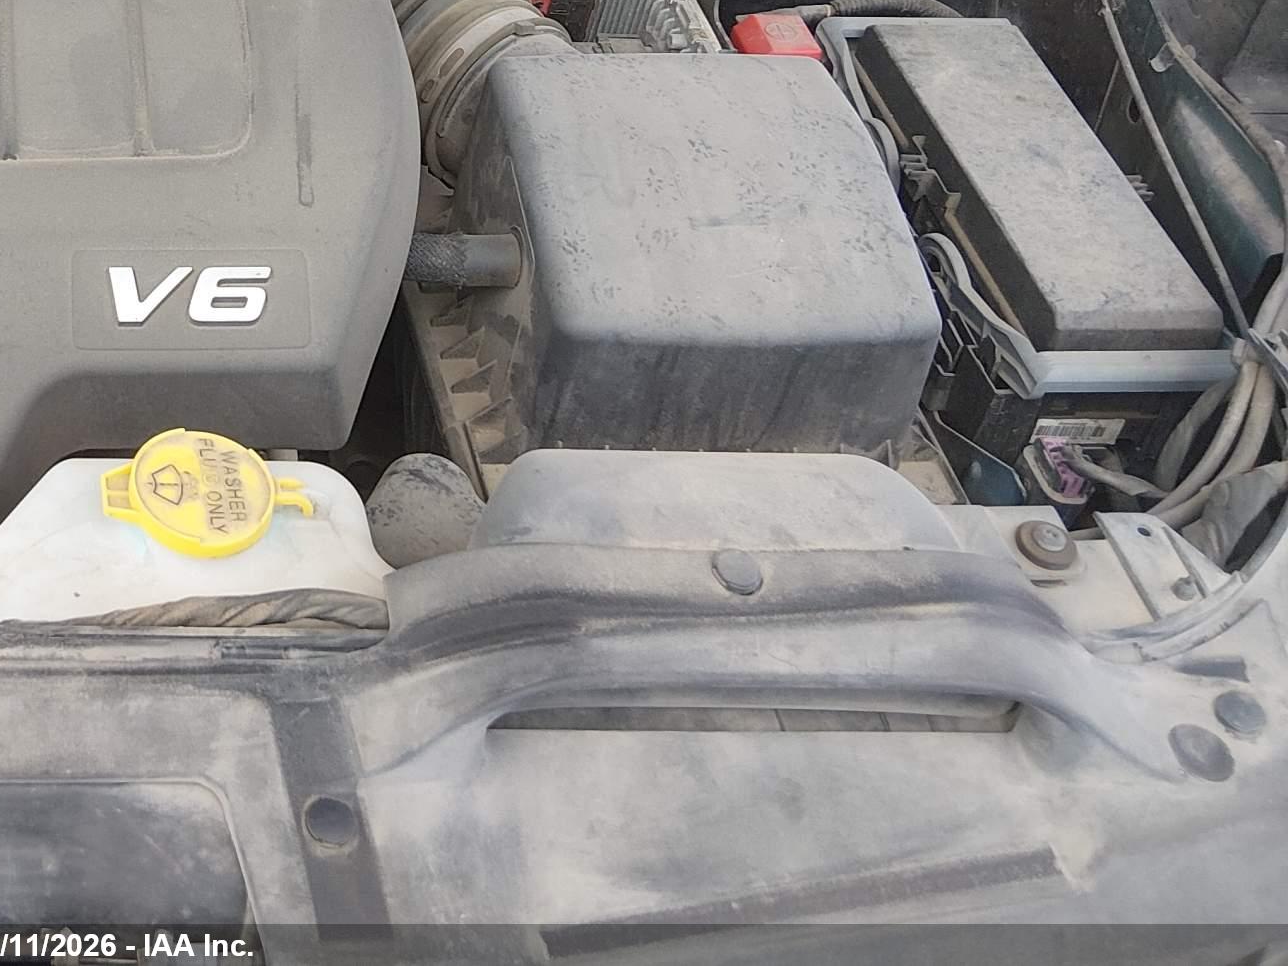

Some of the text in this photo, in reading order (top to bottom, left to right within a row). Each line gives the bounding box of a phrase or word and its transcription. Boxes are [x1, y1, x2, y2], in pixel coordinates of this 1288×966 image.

[108, 266, 272, 325] V6
[198, 438, 230, 534] FLUID ONLY
[220, 450, 248, 522] WASHER
